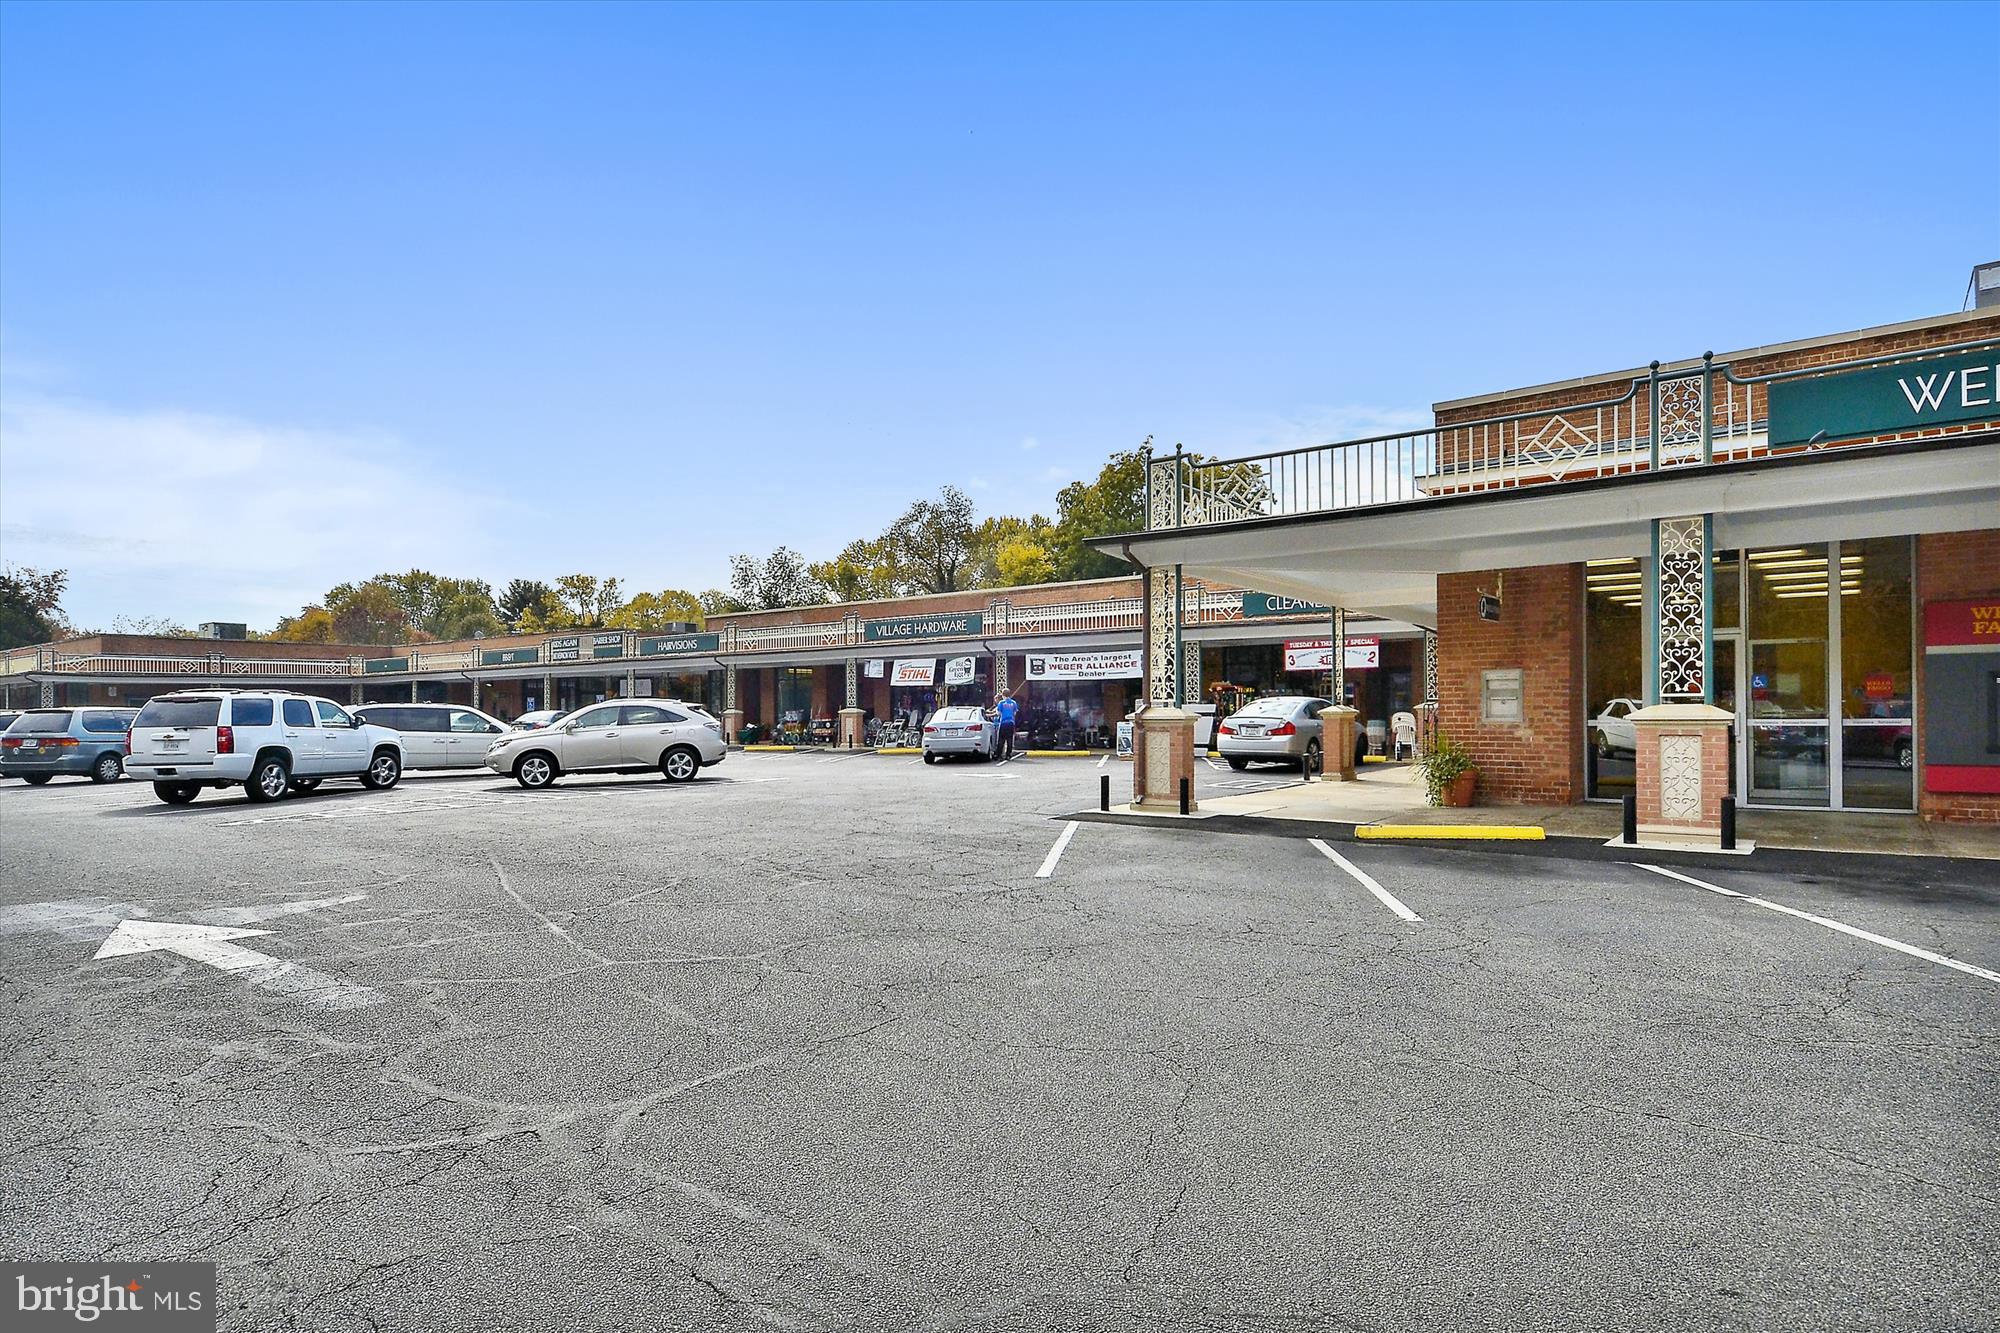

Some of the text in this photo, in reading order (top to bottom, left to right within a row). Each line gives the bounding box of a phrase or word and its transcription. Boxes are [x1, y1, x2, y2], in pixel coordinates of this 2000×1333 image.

[1897, 364, 2000, 414] WE
[875, 620, 967, 636] VILLAGE HARDWARE
[608, 636, 621, 644] SHOP
[657, 639, 698, 651] HAIRVISIONS
[1101, 654, 1132, 662] largest
[1288, 654, 1296, 666] 3
[1367, 651, 1376, 663] 2
[1086, 661, 1138, 669] ALLIANCE
[899, 669, 931, 679] STIHL
